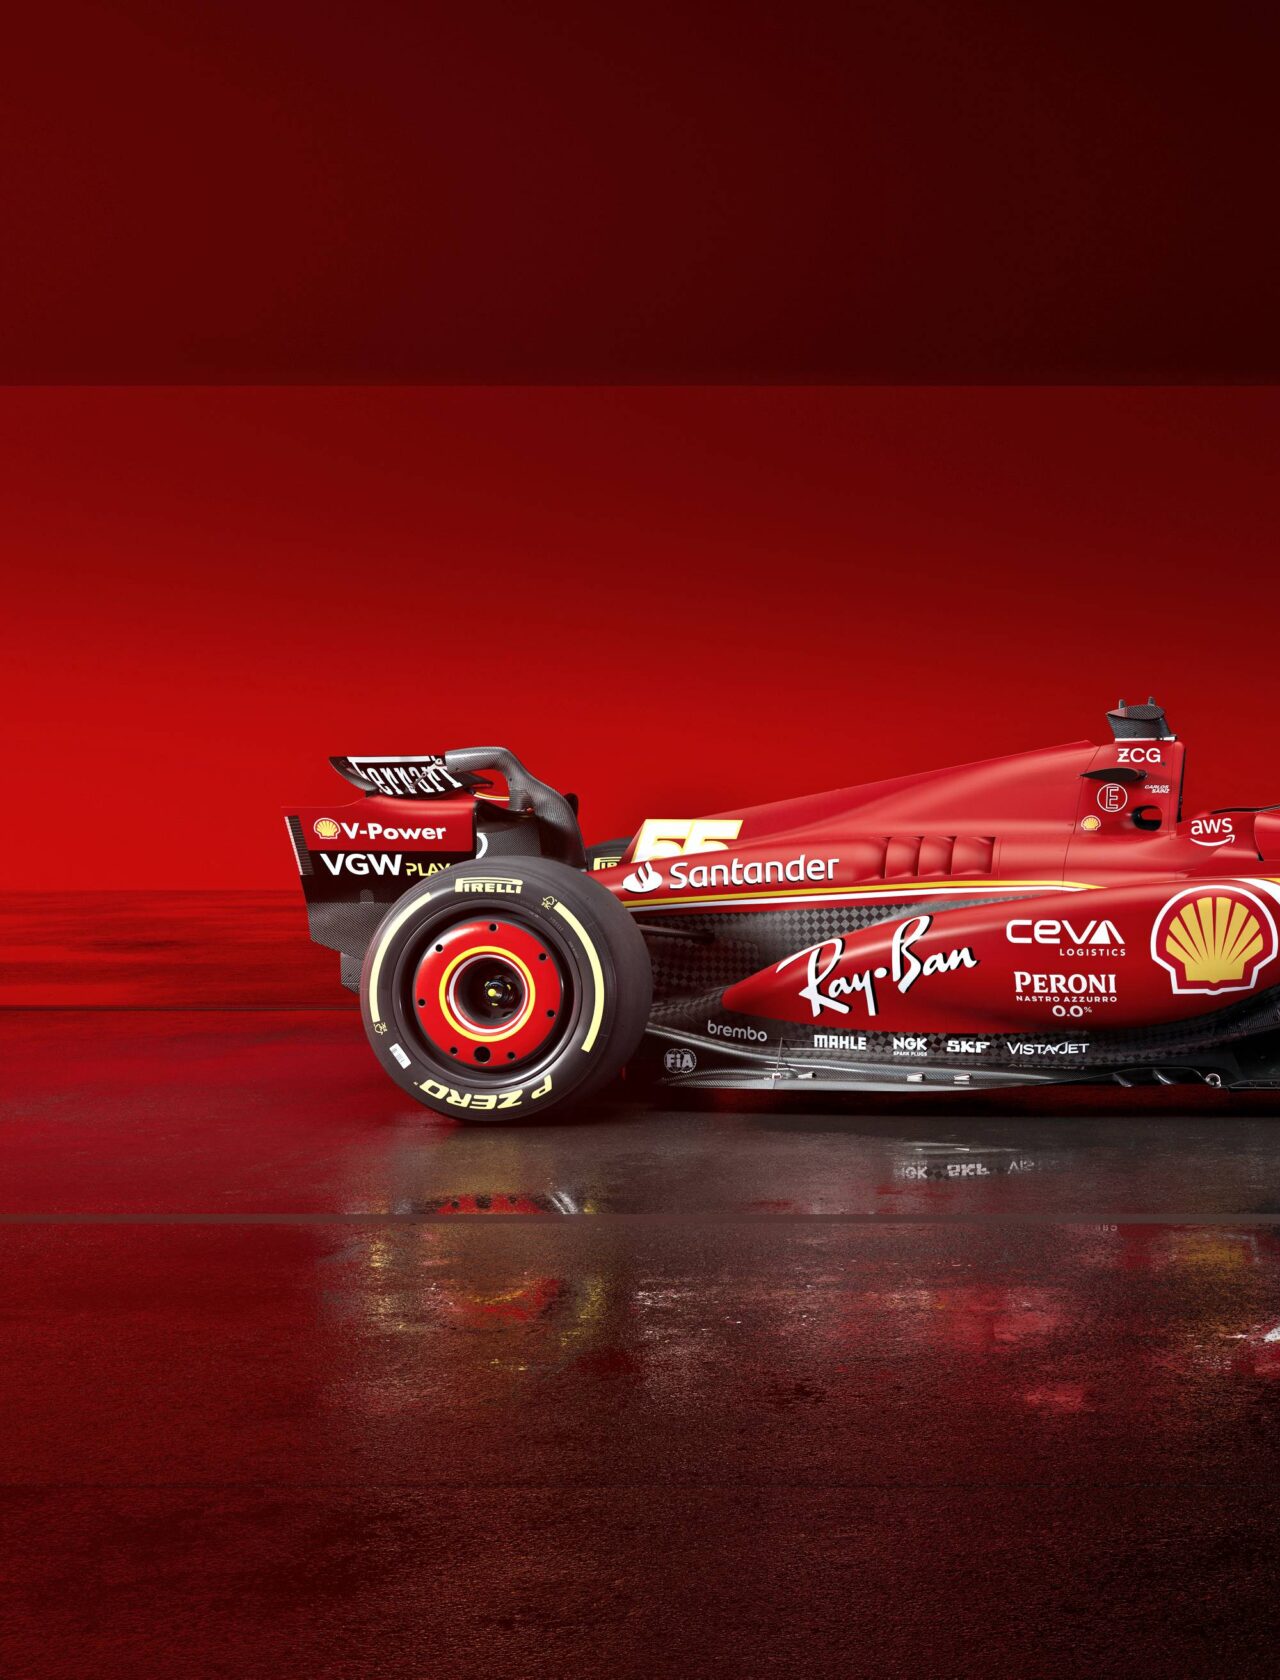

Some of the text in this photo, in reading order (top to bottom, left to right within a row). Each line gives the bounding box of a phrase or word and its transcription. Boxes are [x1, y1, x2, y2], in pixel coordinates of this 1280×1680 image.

[1117, 748, 1161, 763] ZCG
[341, 822, 447, 840] V-Power
[1191, 818, 1233, 835] aws
[320, 853, 403, 876] VGW
[669, 854, 840, 890] Santander
[454, 876, 524, 894] PIRELLI
[1059, 948, 1126, 957] LOGISTICS
[1013, 971, 1117, 994] PERONI
[1016, 995, 1061, 1003] NASTRO
[707, 1020, 768, 1042] brembo
[814, 1035, 867, 1050] MAHLE
[893, 1037, 928, 1051] NGK
[946, 1040, 991, 1053] SKF
[419, 1075, 553, 1110] P ZERO
